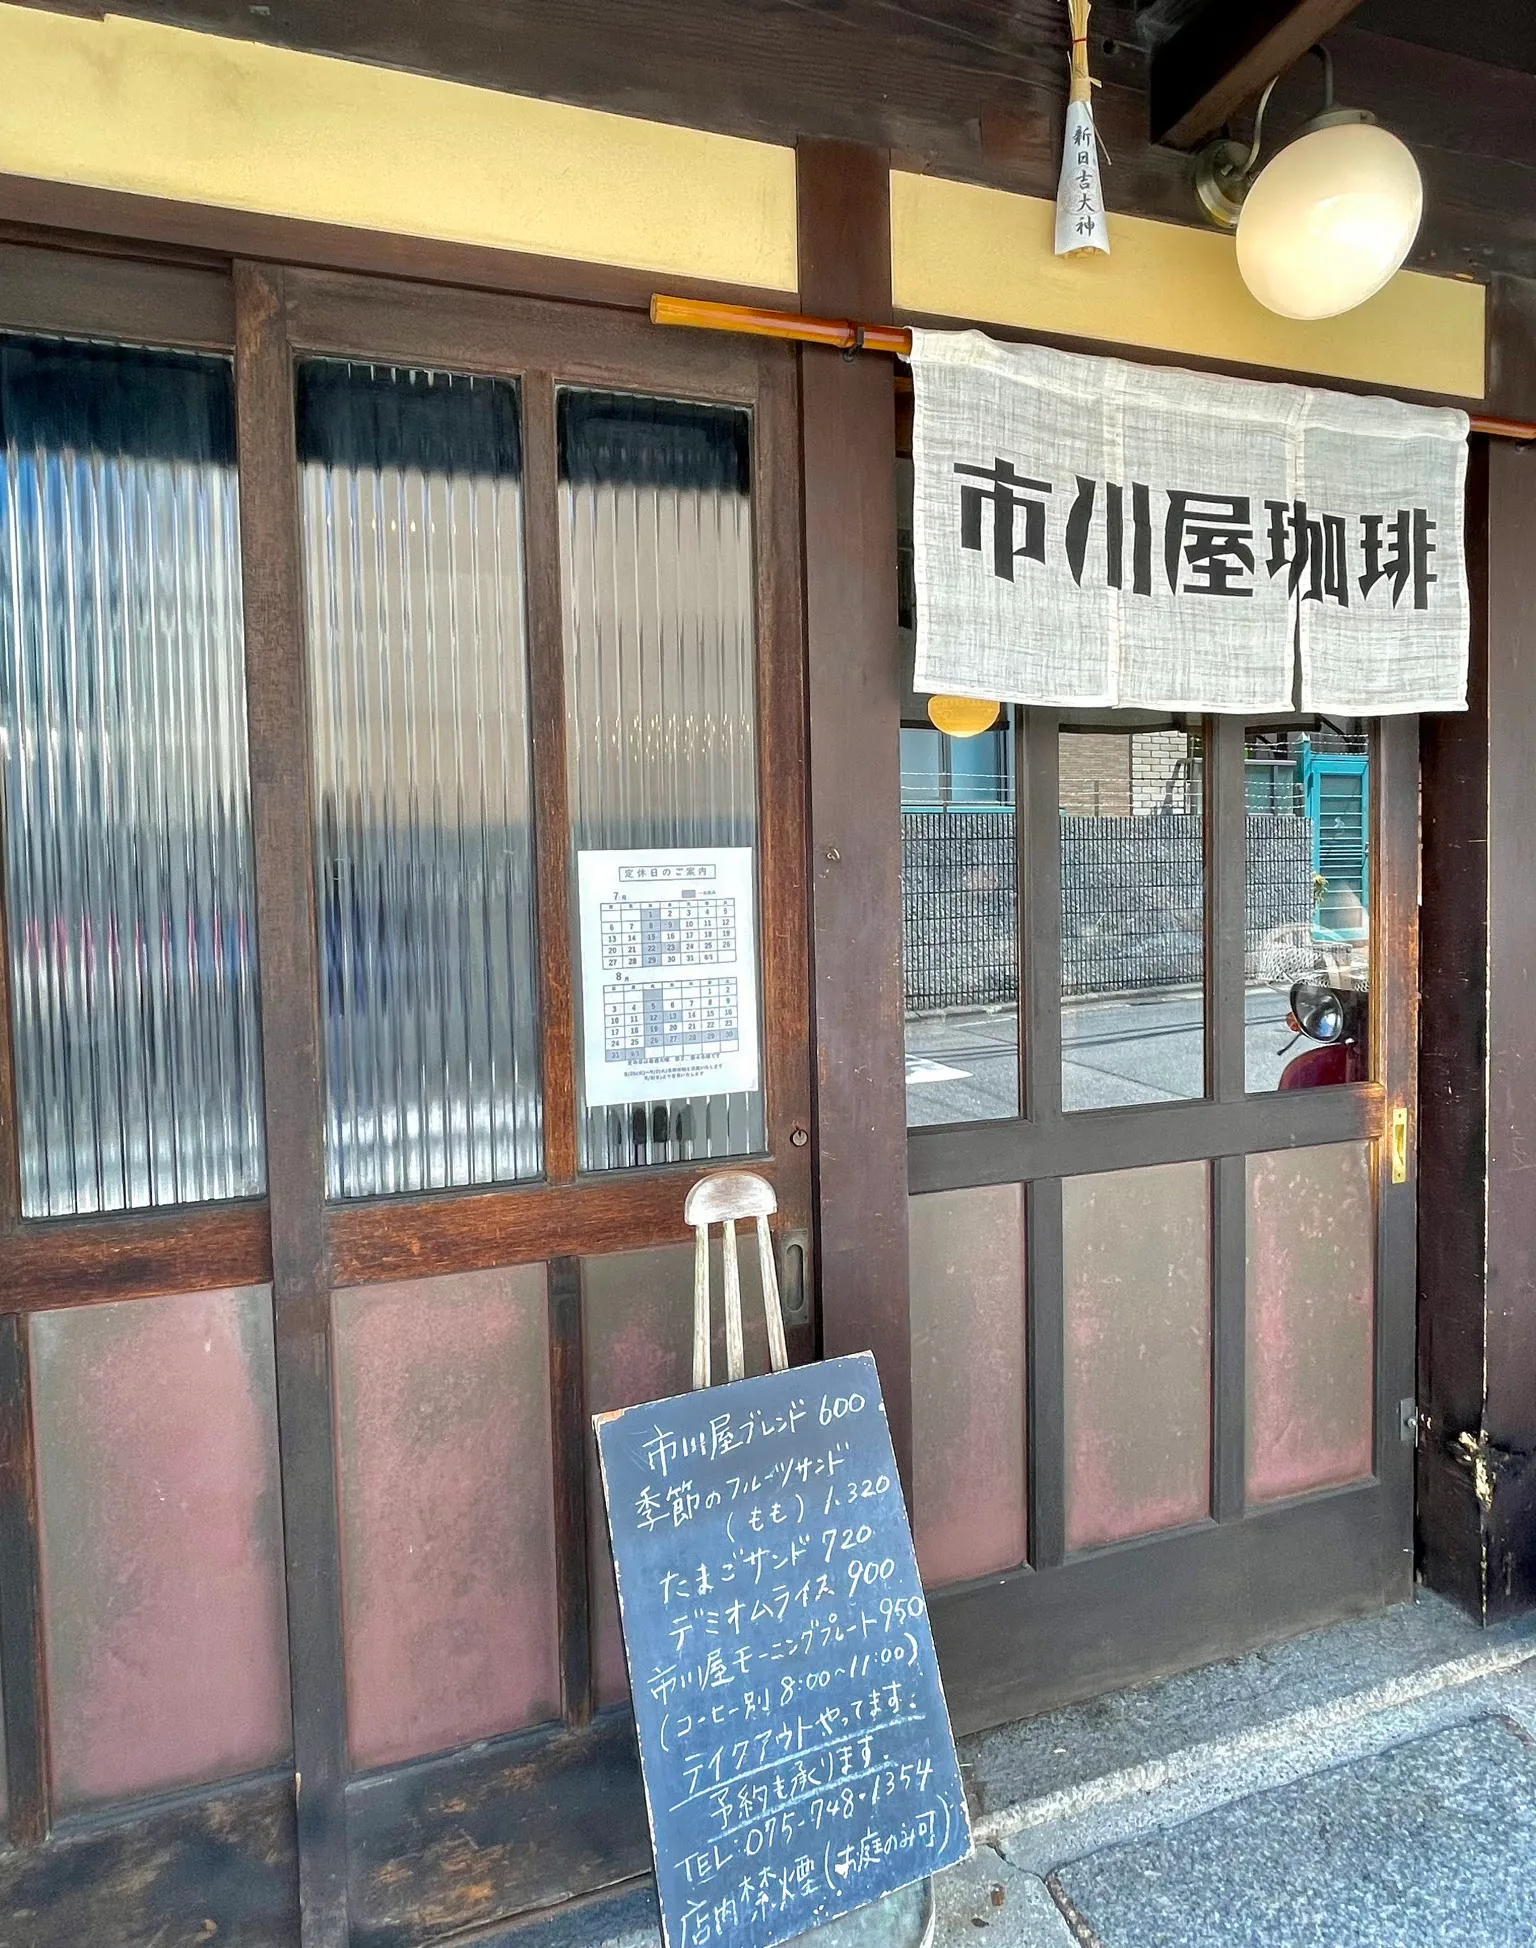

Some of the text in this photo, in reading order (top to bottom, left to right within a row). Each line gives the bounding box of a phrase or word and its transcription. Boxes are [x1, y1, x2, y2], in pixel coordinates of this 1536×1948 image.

[1072, 125, 1096, 237] 新日吉大神
[953, 457, 1438, 610] 市川屋珈琲
[624, 867, 707, 878] 定休日のご案内
[642, 1393, 865, 1476] 市川屋ブレンド 600
[635, 1441, 850, 1531] 季節のフルーツサンド
[659, 1525, 872, 1605] たまごサンド 720
[668, 1558, 895, 1651] デミオムライス 900
[647, 1596, 925, 1705] 市川屋モーニングプレート 950
